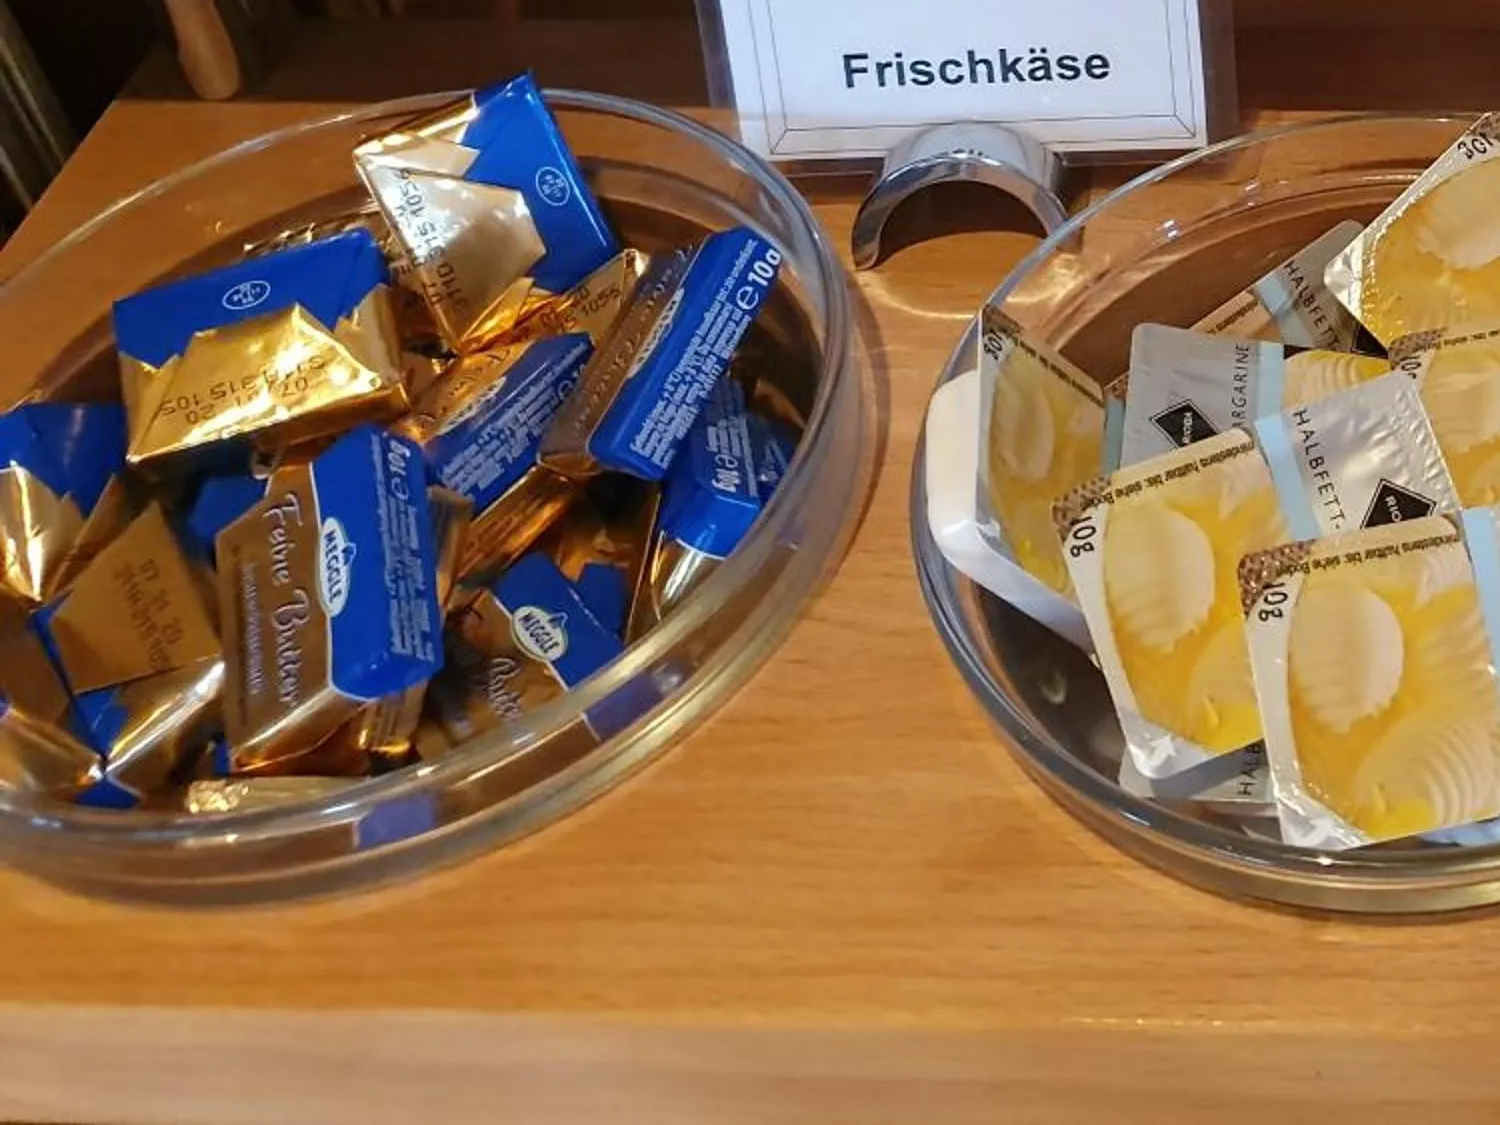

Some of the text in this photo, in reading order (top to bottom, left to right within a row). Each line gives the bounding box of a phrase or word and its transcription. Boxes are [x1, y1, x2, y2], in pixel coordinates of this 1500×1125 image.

[842, 47, 1111, 88] Frischkäse
[1293, 406, 1346, 531] HALBFETT-
[1069, 516, 1097, 559] 10g
[322, 529, 343, 604] MEGGLE
[261, 492, 311, 708] Feine Butter
[1258, 581, 1289, 622] 10g
[517, 611, 560, 654] MEGGLE
